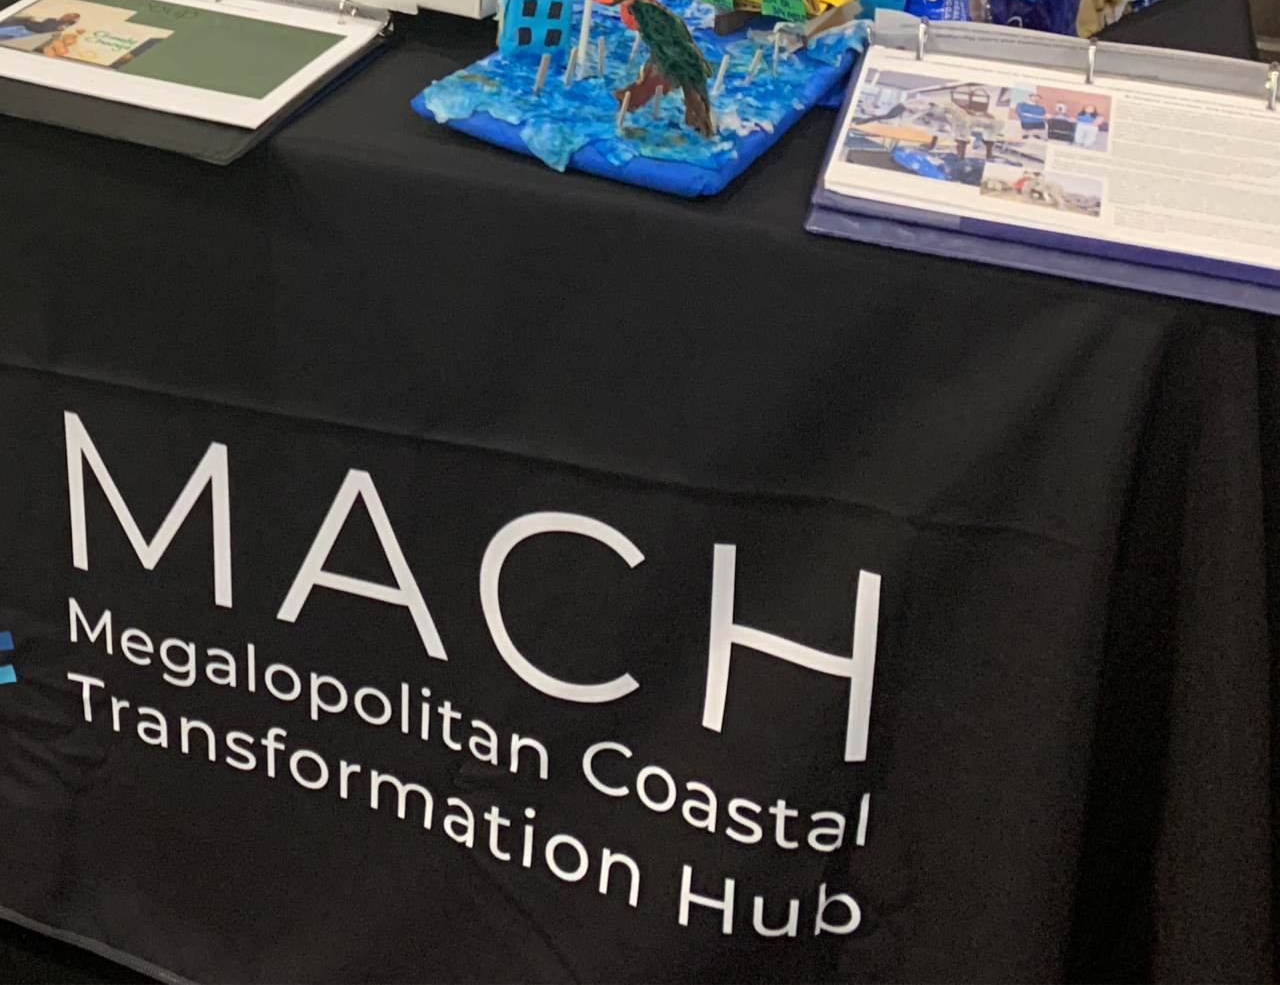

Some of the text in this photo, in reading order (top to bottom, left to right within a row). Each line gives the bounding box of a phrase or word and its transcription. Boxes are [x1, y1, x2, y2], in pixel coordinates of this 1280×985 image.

[64, 409, 883, 763] MACH
[65, 671, 863, 940] Transformation Hub
[66, 596, 871, 854] Megalopolitan Coastal
